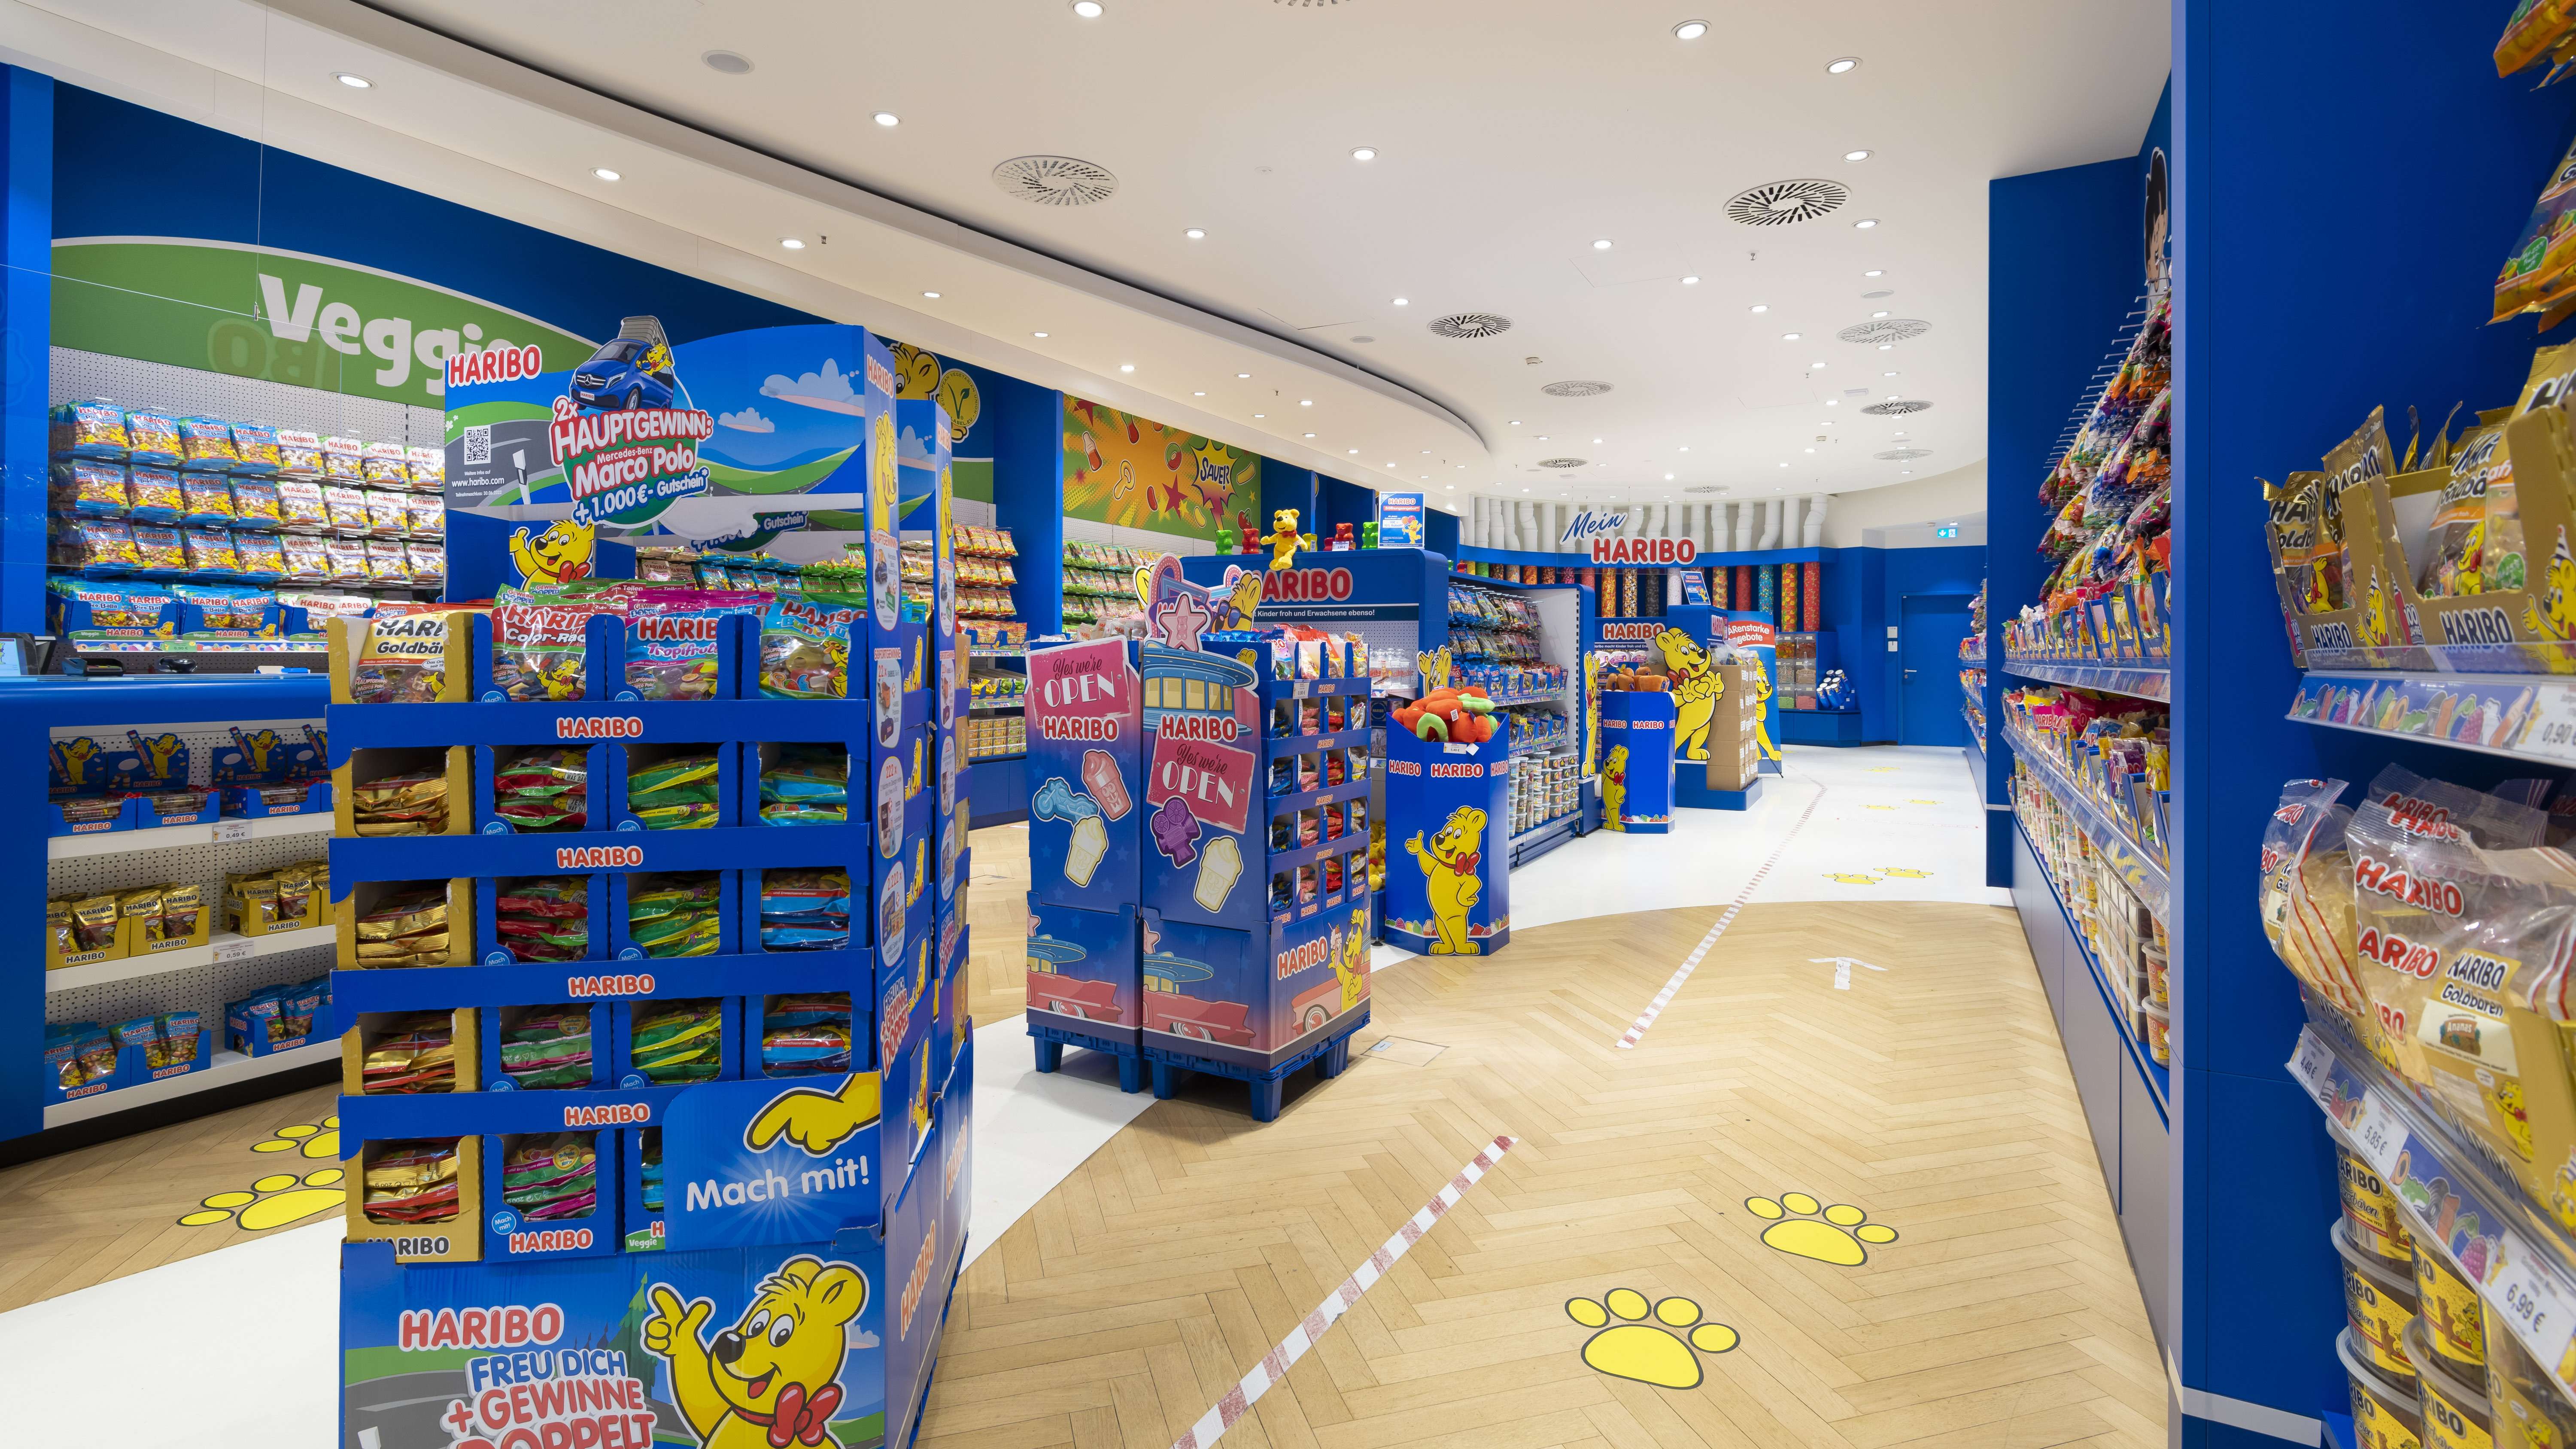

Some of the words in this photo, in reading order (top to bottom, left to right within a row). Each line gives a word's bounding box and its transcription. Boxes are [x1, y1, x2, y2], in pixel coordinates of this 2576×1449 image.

[259, 273, 515, 396] Veggi
[451, 347, 540, 384] HARIBO
[867, 354, 894, 398] HARIBO
[940, 375, 949, 406] EUROPEAN
[951, 372, 975, 392] VEGETARIAN
[556, 399, 578, 419] 2x
[555, 411, 712, 461] HAUPTGEWINN:
[937, 422, 951, 453] HARIBO
[597, 447, 653, 465] Mercedes-Benz
[575, 457, 648, 498] Marco
[654, 442, 694, 474] Polo
[452, 477, 504, 487] www.haribo.com
[592, 489, 636, 518] 1.000
[1562, 511, 1626, 543] Mein
[1594, 539, 1695, 562] HARIBO
[508, 590, 534, 598] GEWINNE
[1263, 570, 1351, 599] ARIBO
[79, 593, 122, 602] HARIBO
[781, 601, 867, 628] HARIBO
[376, 620, 443, 635] HARI
[639, 619, 717, 639] HARIB
[782, 617, 825, 638] Bunte
[1604, 624, 1665, 639] HARIBO
[2313, 623, 2352, 647] HARIBO
[2441, 609, 2513, 644] HARIBO
[1736, 633, 1763, 644] gebote
[1053, 659, 1073, 682] Yes
[1075, 653, 1102, 674] we're
[1044, 672, 1115, 708] OPEN
[1318, 684, 1335, 693] HARIBO
[557, 718, 643, 738] HARIBO
[1045, 718, 1117, 740] HARIBO
[1162, 717, 1236, 741] HARIBO
[2542, 723, 2570, 744] 0,90
[1317, 739, 1334, 749] HARIBO
[1176, 744, 1200, 767] Yes
[1201, 754, 1228, 775] we're
[1389, 759, 1421, 777] HARIBO
[1431, 763, 1482, 777] HARIBO
[1491, 759, 1509, 777] HARIBO
[1163, 761, 1236, 809] OPEN
[270, 805, 300, 814] HARIBO
[1315, 794, 1333, 806] HARIBO
[73, 823, 111, 832] HARIBO
[163, 815, 197, 824] HARIBO
[557, 846, 642, 868] HARIBO
[1315, 848, 1333, 860] HARIBO
[2357, 857, 2464, 915] HARIBO
[126, 901, 157, 911] HARIBO
[166, 895, 197, 903] HARIBO
[1326, 895, 1341, 908] HARIBO
[80, 906, 112, 915] HARIBO
[1301, 903, 1317, 917] HARIBO
[268, 921, 300, 931] HARIBO
[151, 939, 187, 950] HARIBO
[66, 952, 105, 963] HARIBO
[488, 957, 505, 965] Mach
[622, 952, 639, 960] Mach
[1278, 937, 1327, 980] HARIBO
[2358, 933, 2439, 978] ARIBO
[2448, 953, 2506, 991] HARIBO
[568, 975, 655, 996] HARIBO
[884, 984, 896, 1008] FREU
[885, 989, 907, 1029] GEWINNE
[2442, 984, 2504, 1017] Goldbären
[230, 1017, 247, 1031] HARIBO
[2447, 1021, 2473, 1034] Ananas
[273, 1038, 305, 1051] HARIBO
[884, 1005, 909, 1080] DOPPELT
[153, 1065, 189, 1078] HARIBO
[2300, 1056, 2312, 1075] 4,49
[2311, 1068, 2317, 1078] €
[67, 1084, 107, 1098] HARIBO
[565, 1103, 650, 1126] HARIBO
[2365, 1126, 2379, 1148] 5,85
[2380, 1141, 2388, 1154] €
[687, 1169, 788, 1212] Mach
[801, 1156, 869, 1194] mit!
[495, 1213, 512, 1224] Mach
[510, 1230, 592, 1252] HARIBO
[629, 1237, 657, 1247] Veggie
[900, 1219, 936, 1342] HARIBO
[2507, 1284, 2533, 1319] 6,99
[2533, 1312, 2546, 1333] €
[402, 1305, 562, 1349] HARIBO
[471, 1351, 554, 1392] FREU
[562, 1349, 626, 1376] DICH
[479, 1376, 643, 1430] GEWINNE
